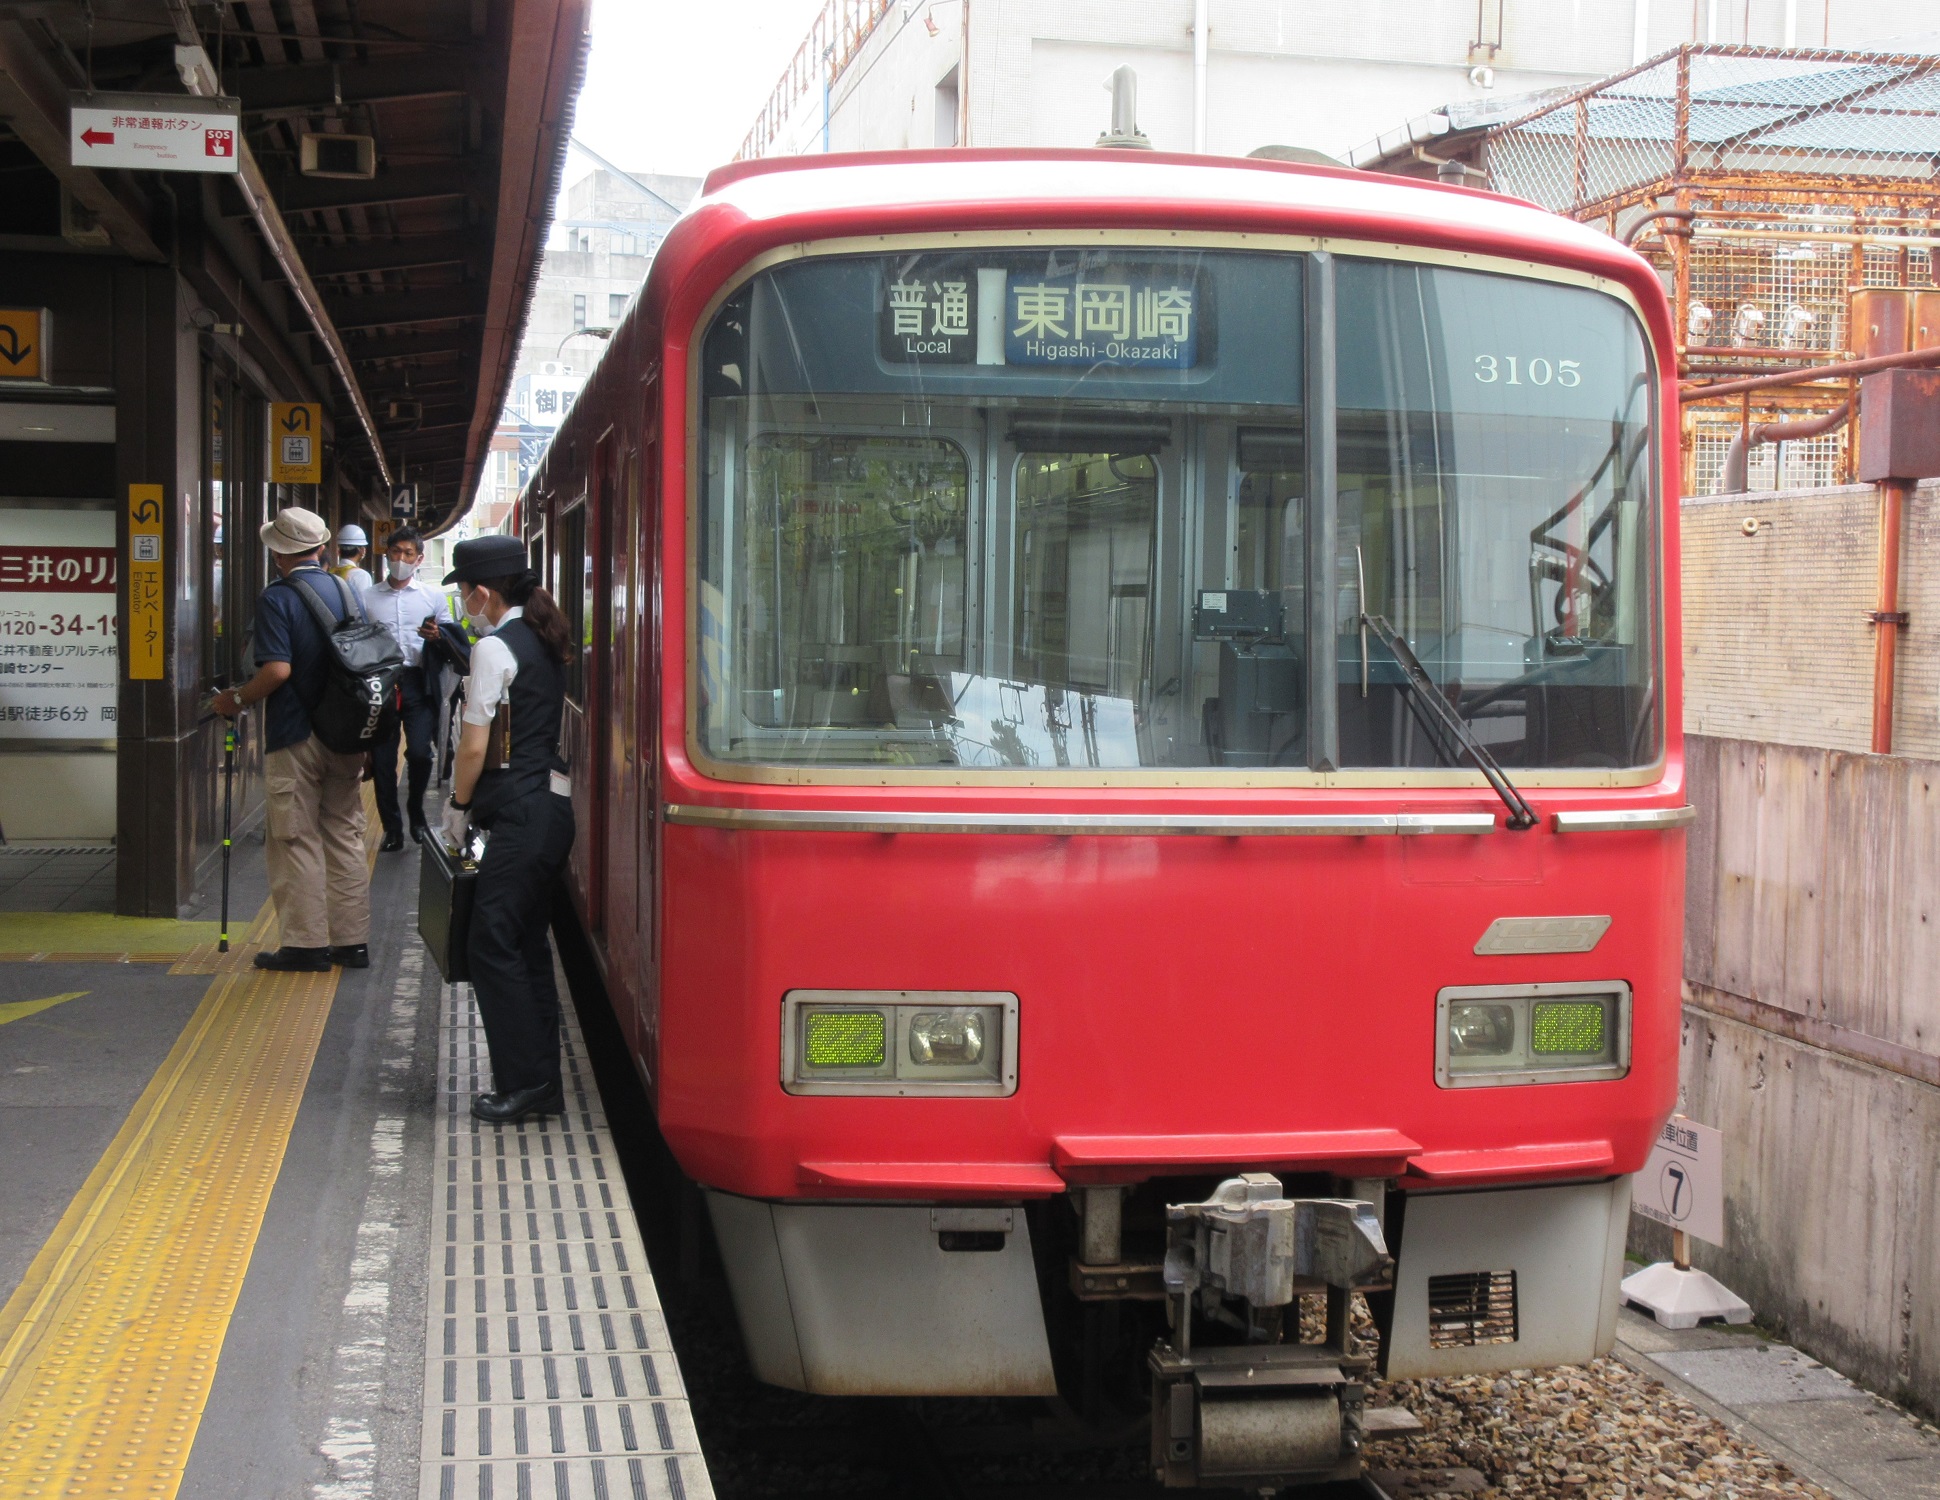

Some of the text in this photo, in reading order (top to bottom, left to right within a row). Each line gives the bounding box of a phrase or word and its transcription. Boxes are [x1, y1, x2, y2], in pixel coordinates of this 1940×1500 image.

[112, 116, 203, 131] 非常通報ボタン
[207, 130, 231, 139] SOS
[133, 142, 168, 150] Emergency
[890, 279, 1193, 342] 普通 東岡崎
[906, 338, 1178, 360] Local Higashi-Okazaki
[1474, 354, 1581, 388] 3105
[393, 489, 413, 513] 4
[133, 572, 142, 614] Elevator
[143, 571, 159, 657] エレベーター
[0, 662, 64, 674] 崎センター
[1669, 1167, 1683, 1214] 7
